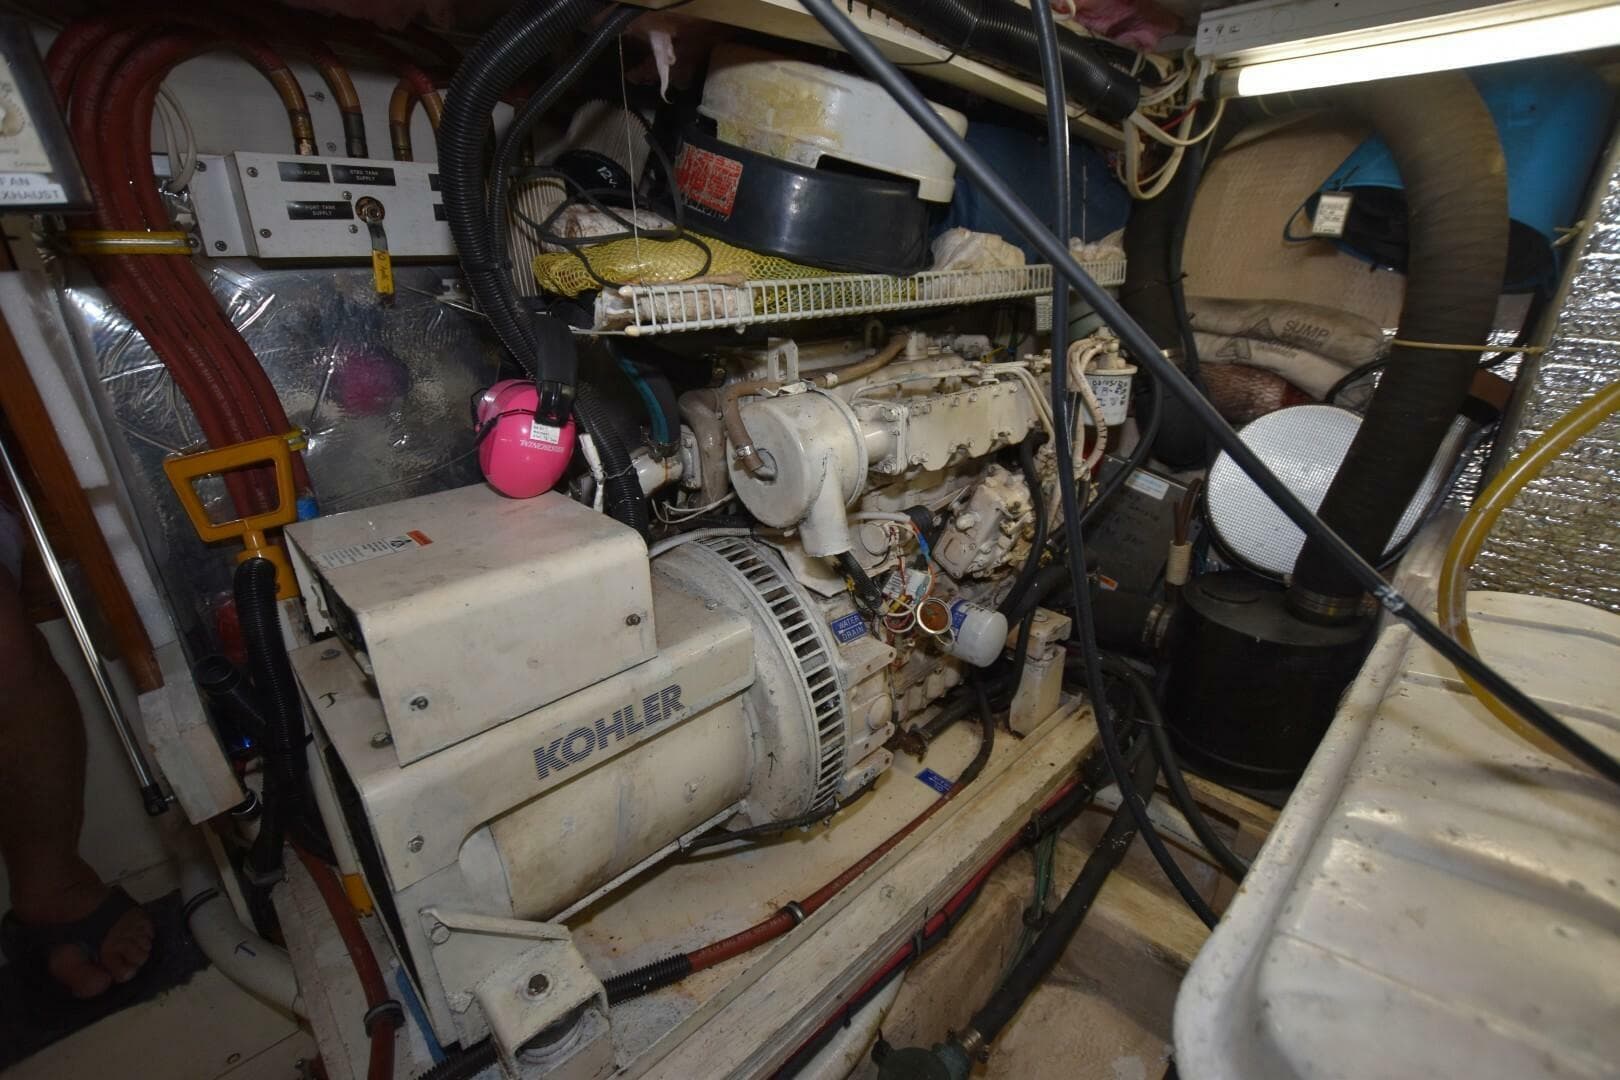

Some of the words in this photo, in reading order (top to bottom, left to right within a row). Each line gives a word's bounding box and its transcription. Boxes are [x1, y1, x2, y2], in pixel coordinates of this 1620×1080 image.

[0, 190, 60, 200] XHAUST
[1284, 320, 1329, 338] SUMP
[839, 615, 860, 630] WATER
[841, 624, 865, 641] DRAIN
[534, 684, 686, 781] KOHLER
